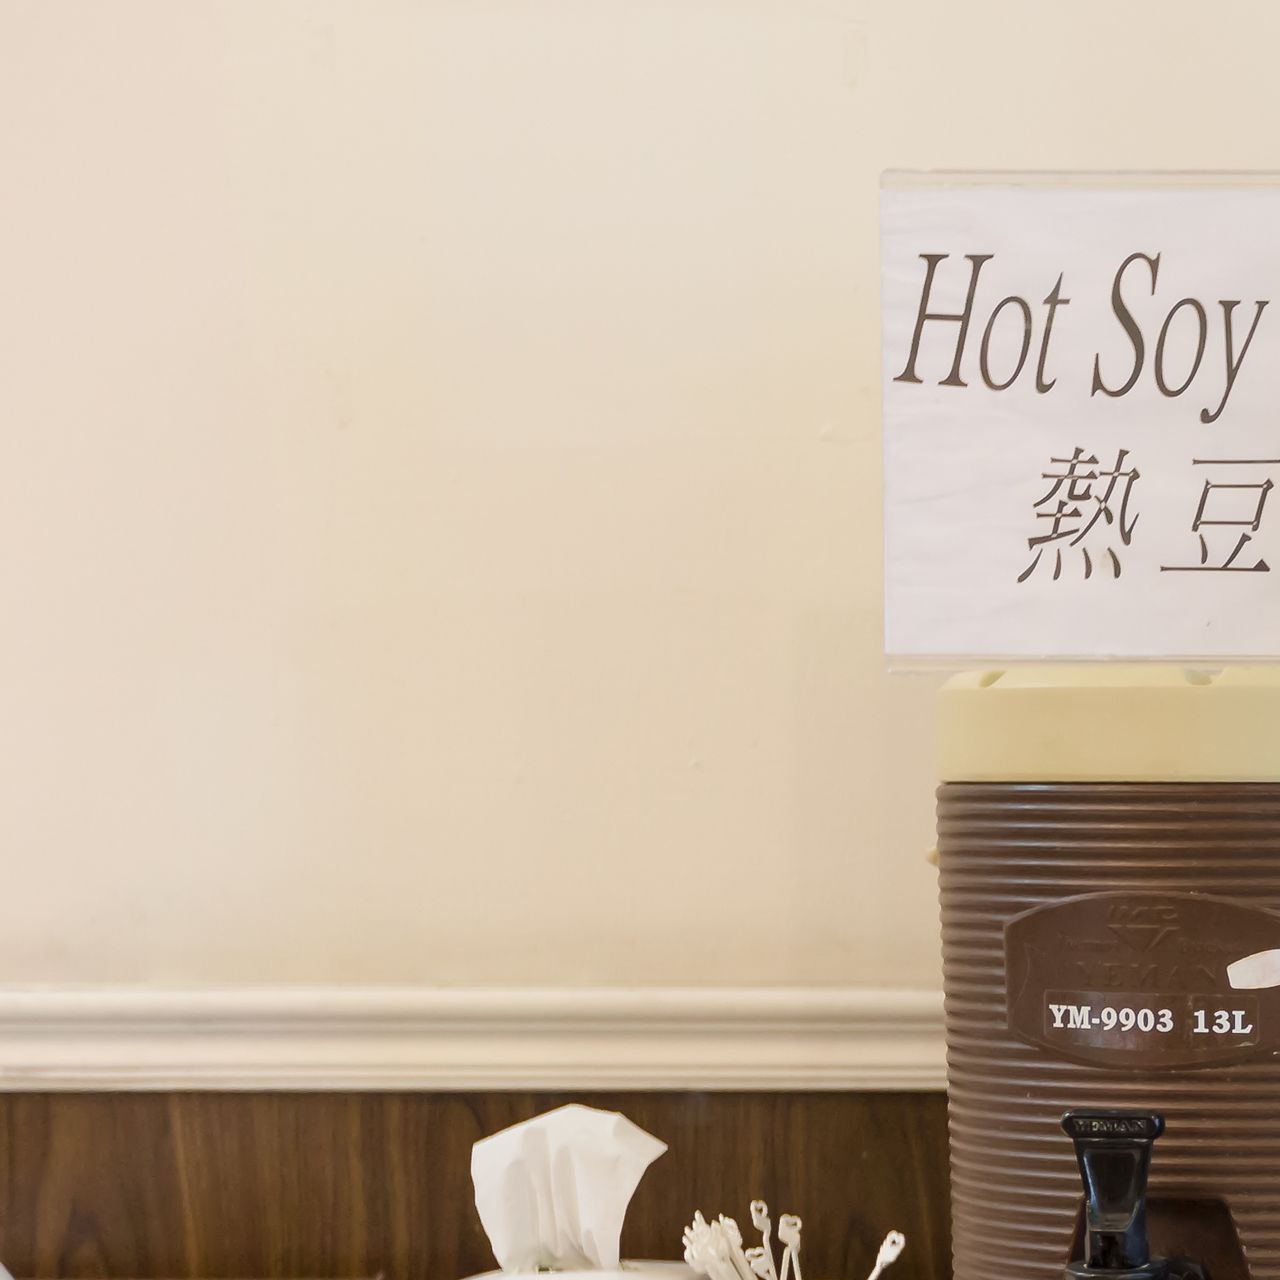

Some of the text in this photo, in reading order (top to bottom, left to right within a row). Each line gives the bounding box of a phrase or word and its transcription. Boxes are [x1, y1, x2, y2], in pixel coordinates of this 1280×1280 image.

[893, 253, 1071, 395] Hot
[1090, 252, 1270, 424] Soy
[1049, 1003, 1253, 1034] YM-9903 13L
